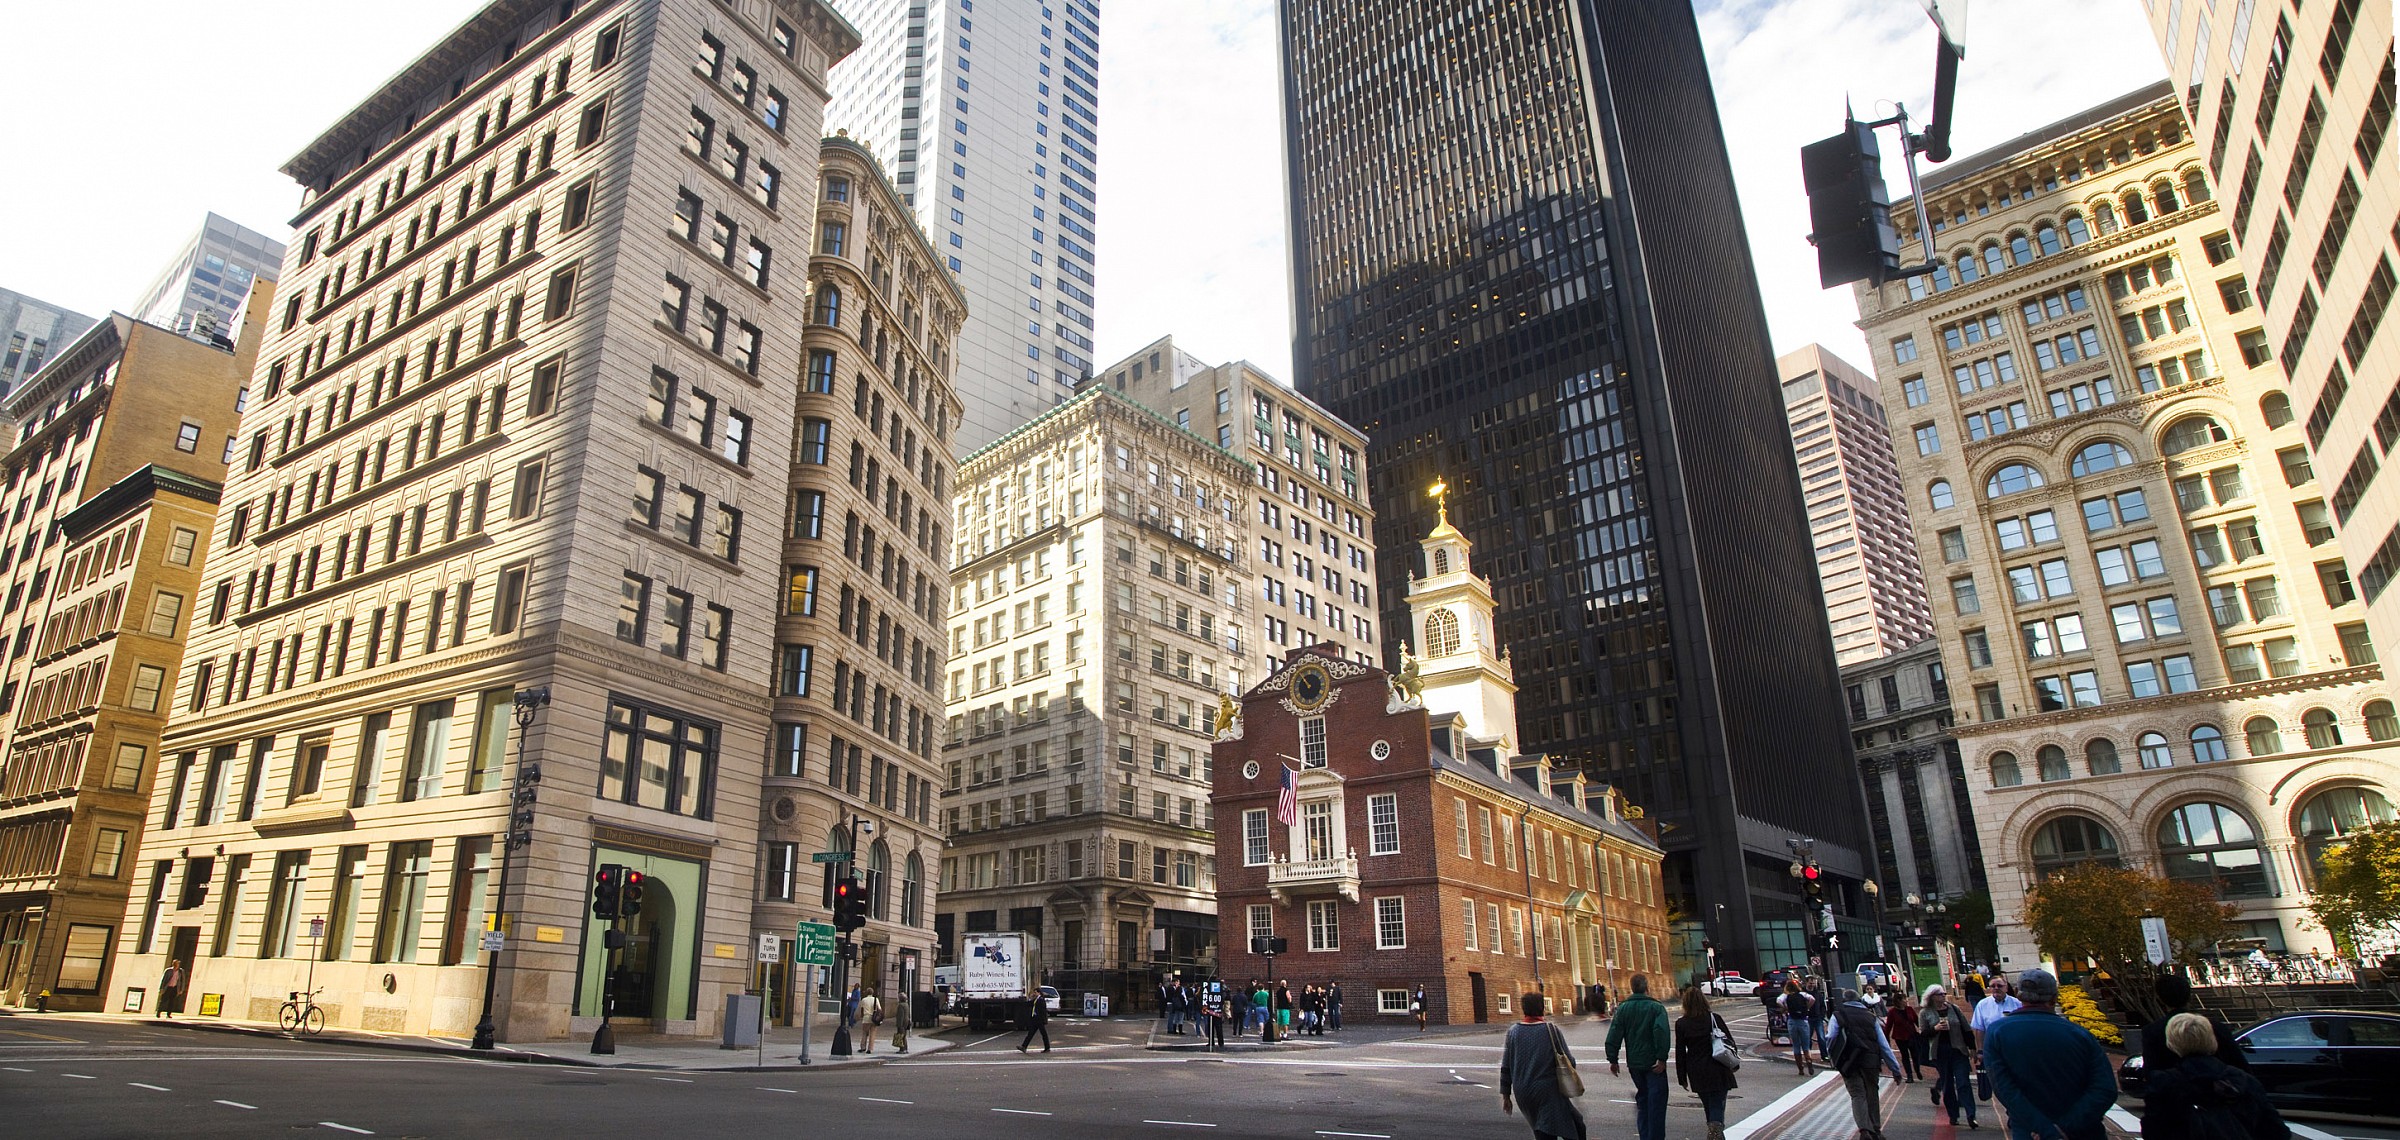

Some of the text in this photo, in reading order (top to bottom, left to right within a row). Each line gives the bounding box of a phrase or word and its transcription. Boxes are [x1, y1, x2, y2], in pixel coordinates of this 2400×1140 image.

[605, 829, 618, 839] The
[619, 832, 632, 842] First
[633, 834, 658, 847] National
[659, 839, 674, 850] Bank
[674, 841, 681, 850] of
[819, 853, 845, 861] CONGRESS
[969, 971, 983, 979] Ruby
